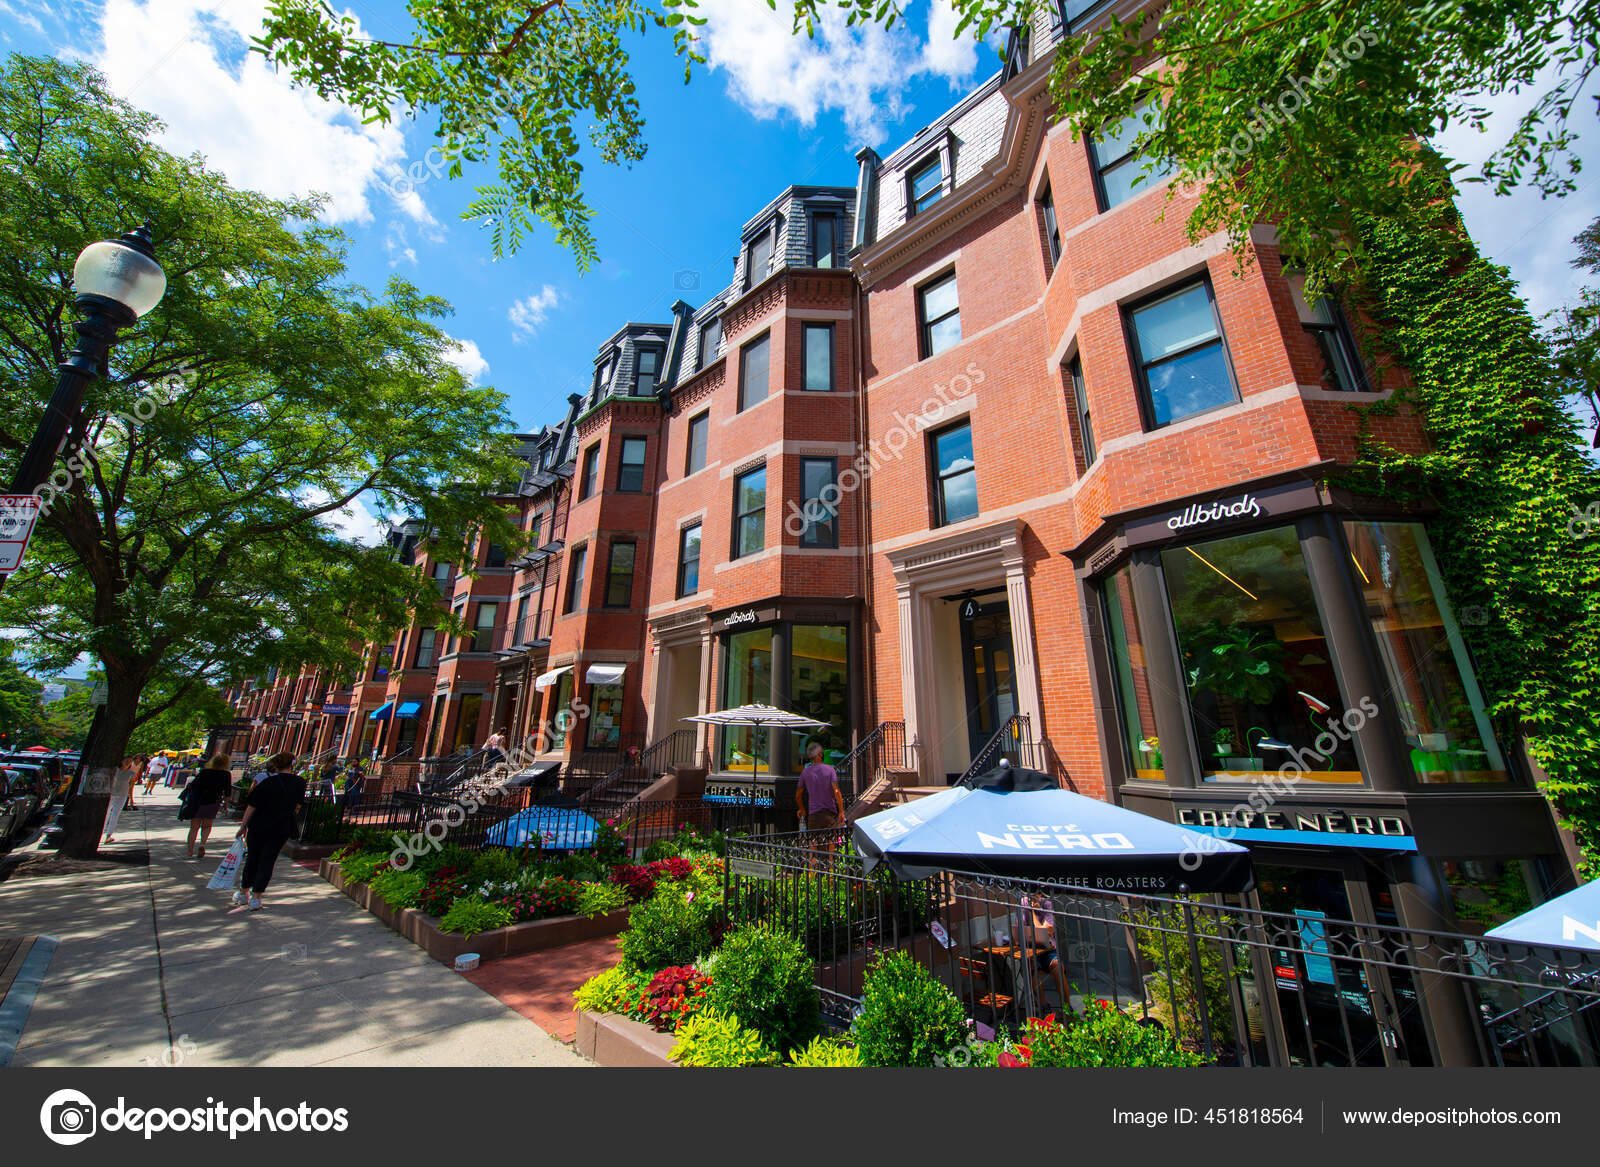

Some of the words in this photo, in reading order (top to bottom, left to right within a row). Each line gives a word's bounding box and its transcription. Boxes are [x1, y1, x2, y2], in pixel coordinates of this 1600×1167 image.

[1167, 494, 1261, 530] allbirds
[724, 609, 755, 625] allbirds
[977, 832, 1135, 849] NERO
[1096, 876, 1166, 888] ROASTERS
